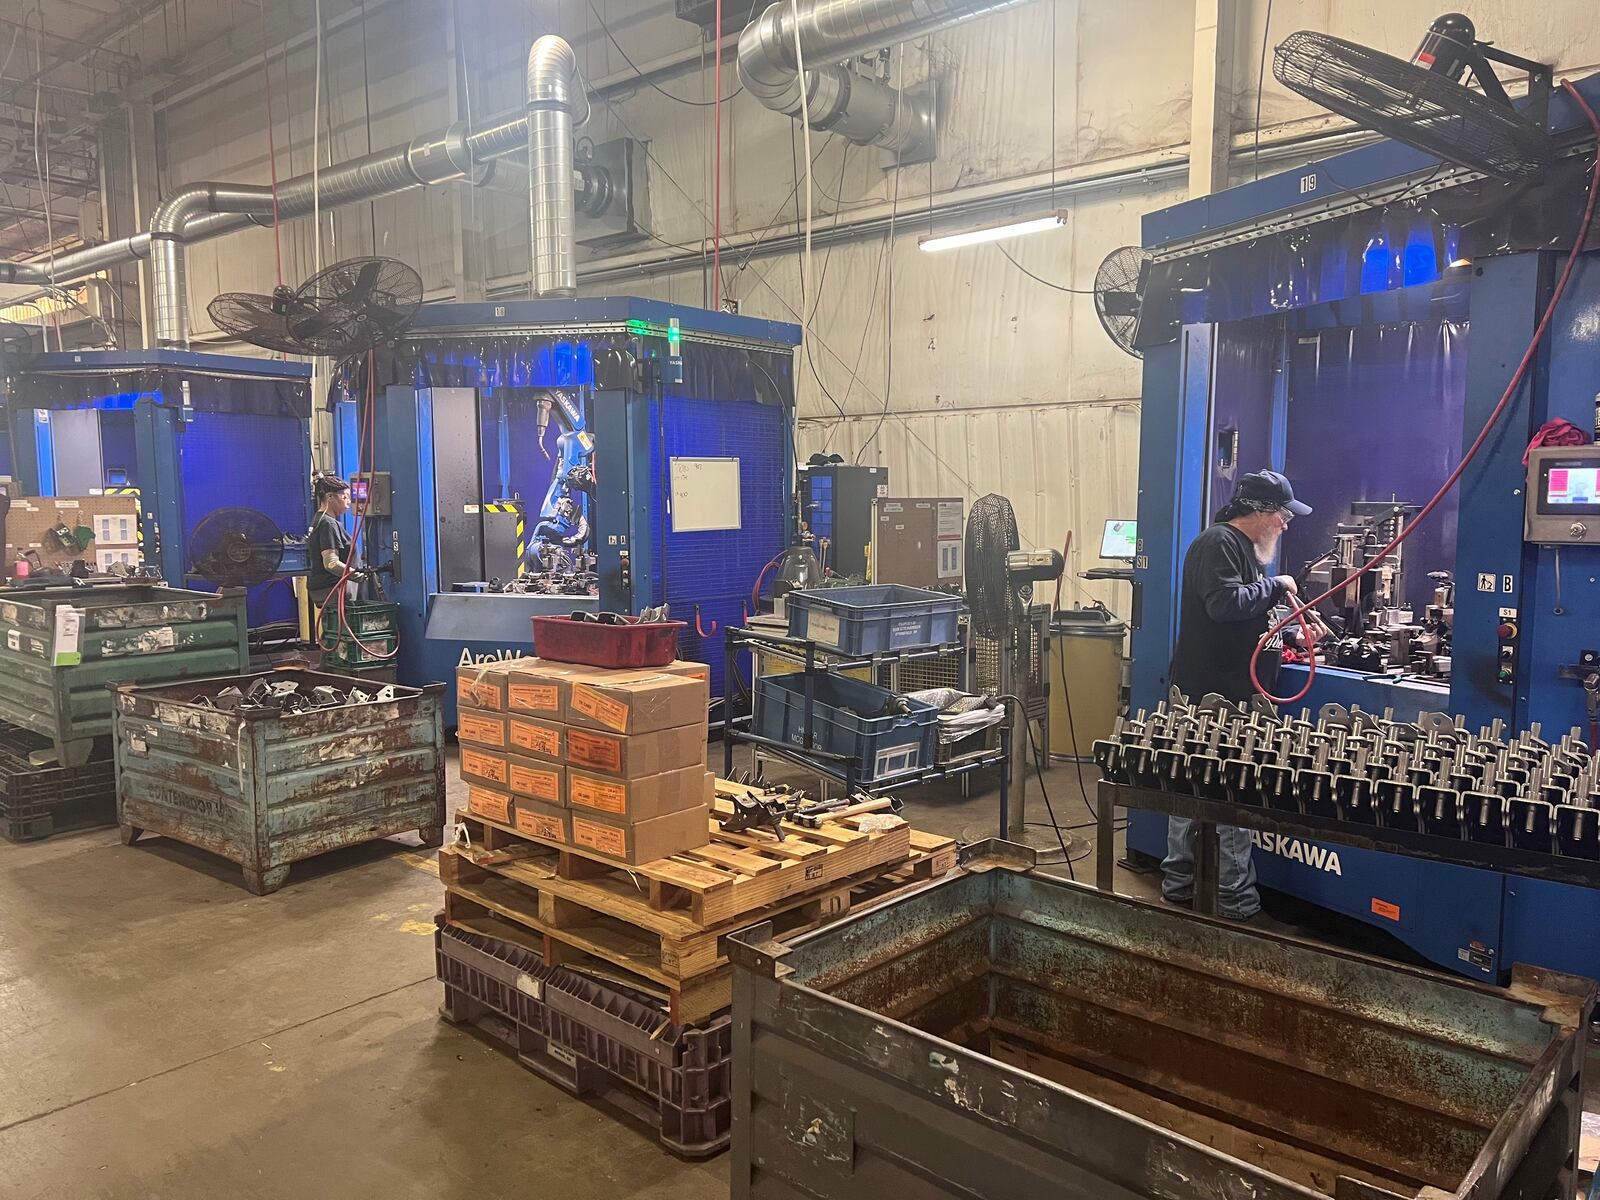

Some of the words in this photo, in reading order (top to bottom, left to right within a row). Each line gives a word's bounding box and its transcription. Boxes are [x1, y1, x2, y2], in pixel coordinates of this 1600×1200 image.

[1302, 175, 1316, 192] 19
[555, 389, 580, 422] YASKAWA
[1137, 555, 1148, 568] S1
[1504, 576, 1512, 592] B
[458, 647, 521, 668] ArcW
[1250, 829, 1342, 876] ASKAWA
